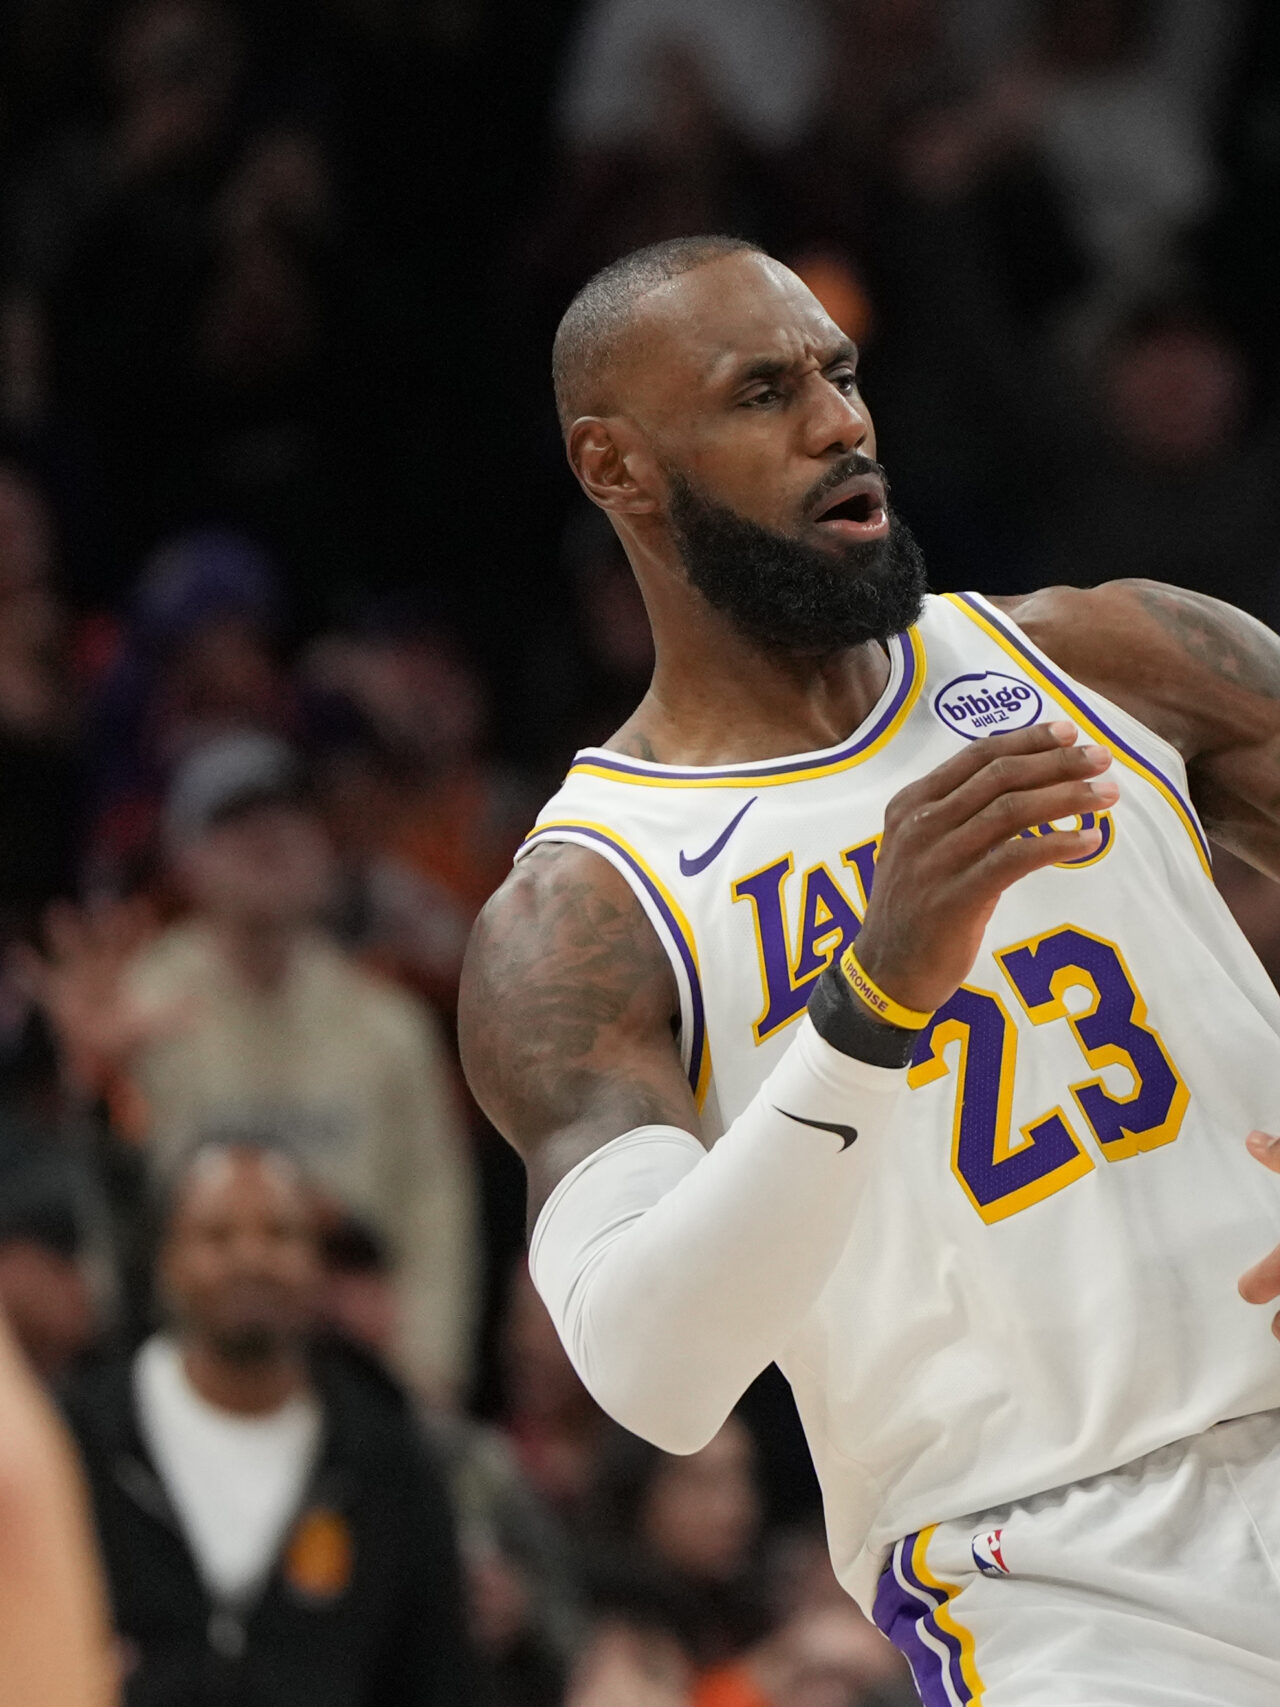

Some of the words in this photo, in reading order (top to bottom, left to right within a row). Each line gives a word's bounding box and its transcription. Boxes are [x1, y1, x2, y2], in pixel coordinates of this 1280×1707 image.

[943, 686, 1031, 720] bibigo
[846, 963, 889, 1013] PROMISE
[907, 922, 1191, 1226] 23
